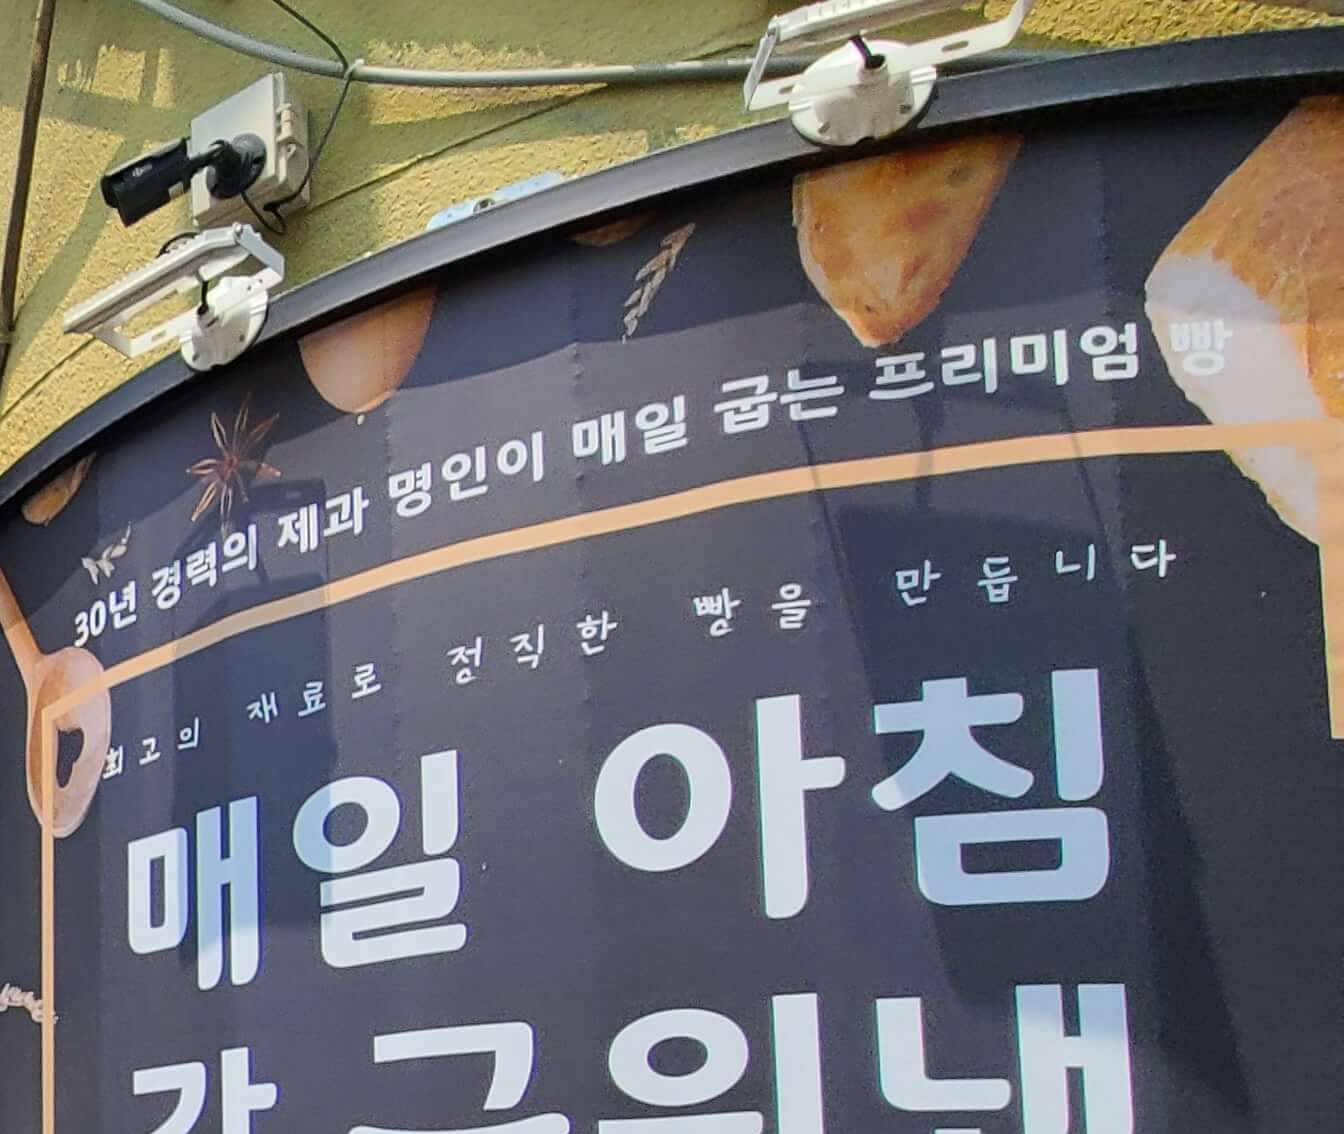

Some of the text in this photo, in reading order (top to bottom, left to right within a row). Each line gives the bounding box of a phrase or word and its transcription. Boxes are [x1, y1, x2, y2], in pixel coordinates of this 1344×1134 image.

[74, 320, 1233, 648] 30년 경력의 제과 명인이 매일 굽는 프리미엄 빵
[102, 538, 1176, 780] 최고의 재료로 정직한 빵을 만듭니다
[127, 668, 1110, 990] 매일 아침
